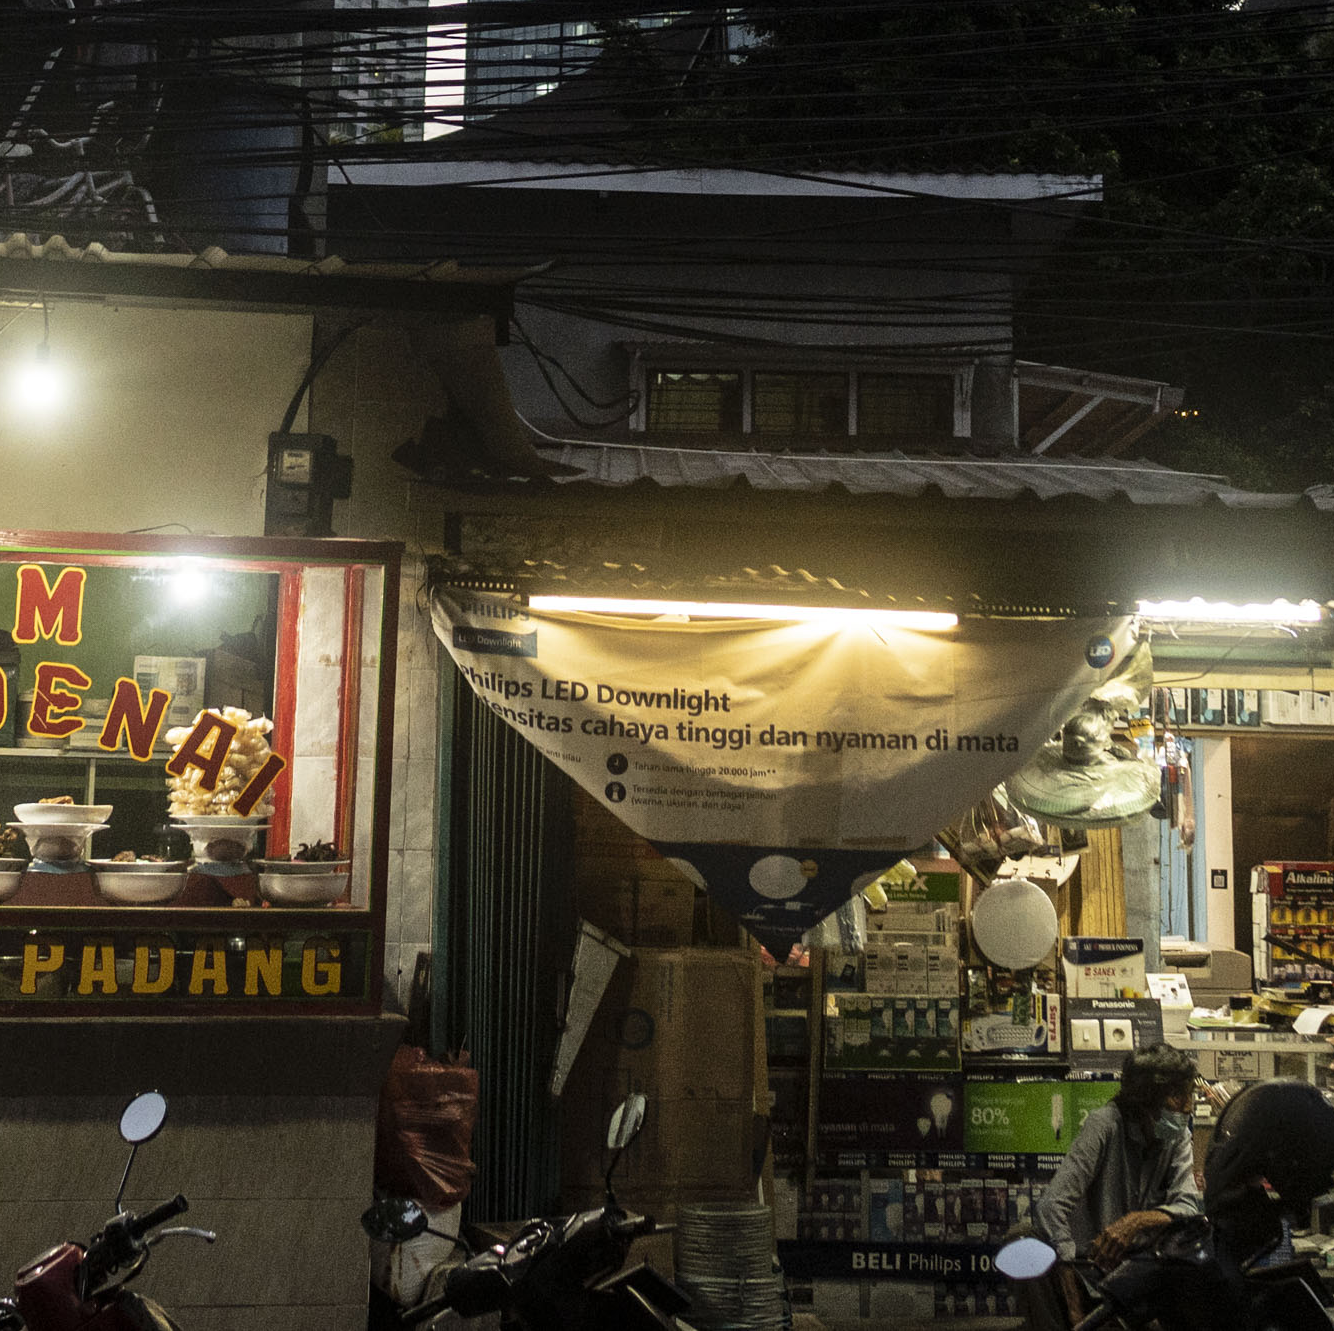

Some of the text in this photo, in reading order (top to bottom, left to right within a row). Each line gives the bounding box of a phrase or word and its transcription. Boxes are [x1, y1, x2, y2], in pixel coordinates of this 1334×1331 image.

[477, 635, 522, 648] Downlight
[1090, 644, 1111, 657] LED
[540, 678, 589, 702] LED
[596, 684, 731, 716] Downlight
[580, 715, 669, 745] cahaya
[675, 720, 752, 750] tinggi
[759, 725, 808, 747] dan
[817, 731, 917, 753] nyaman
[925, 729, 949, 752] di
[956, 733, 1019, 753] mata
[718, 766, 749, 777] 20.000
[1285, 871, 1334, 885] Alkaline
[20, 942, 343, 996] PADANG
[1093, 967, 1116, 977] SANEX
[1092, 999, 1136, 1009] Panasonic
[1048, 1005, 1058, 1041] Surya
[971, 1107, 1010, 1125] 80%
[852, 1252, 901, 1270] BELI
[908, 1252, 962, 1275] Philips
